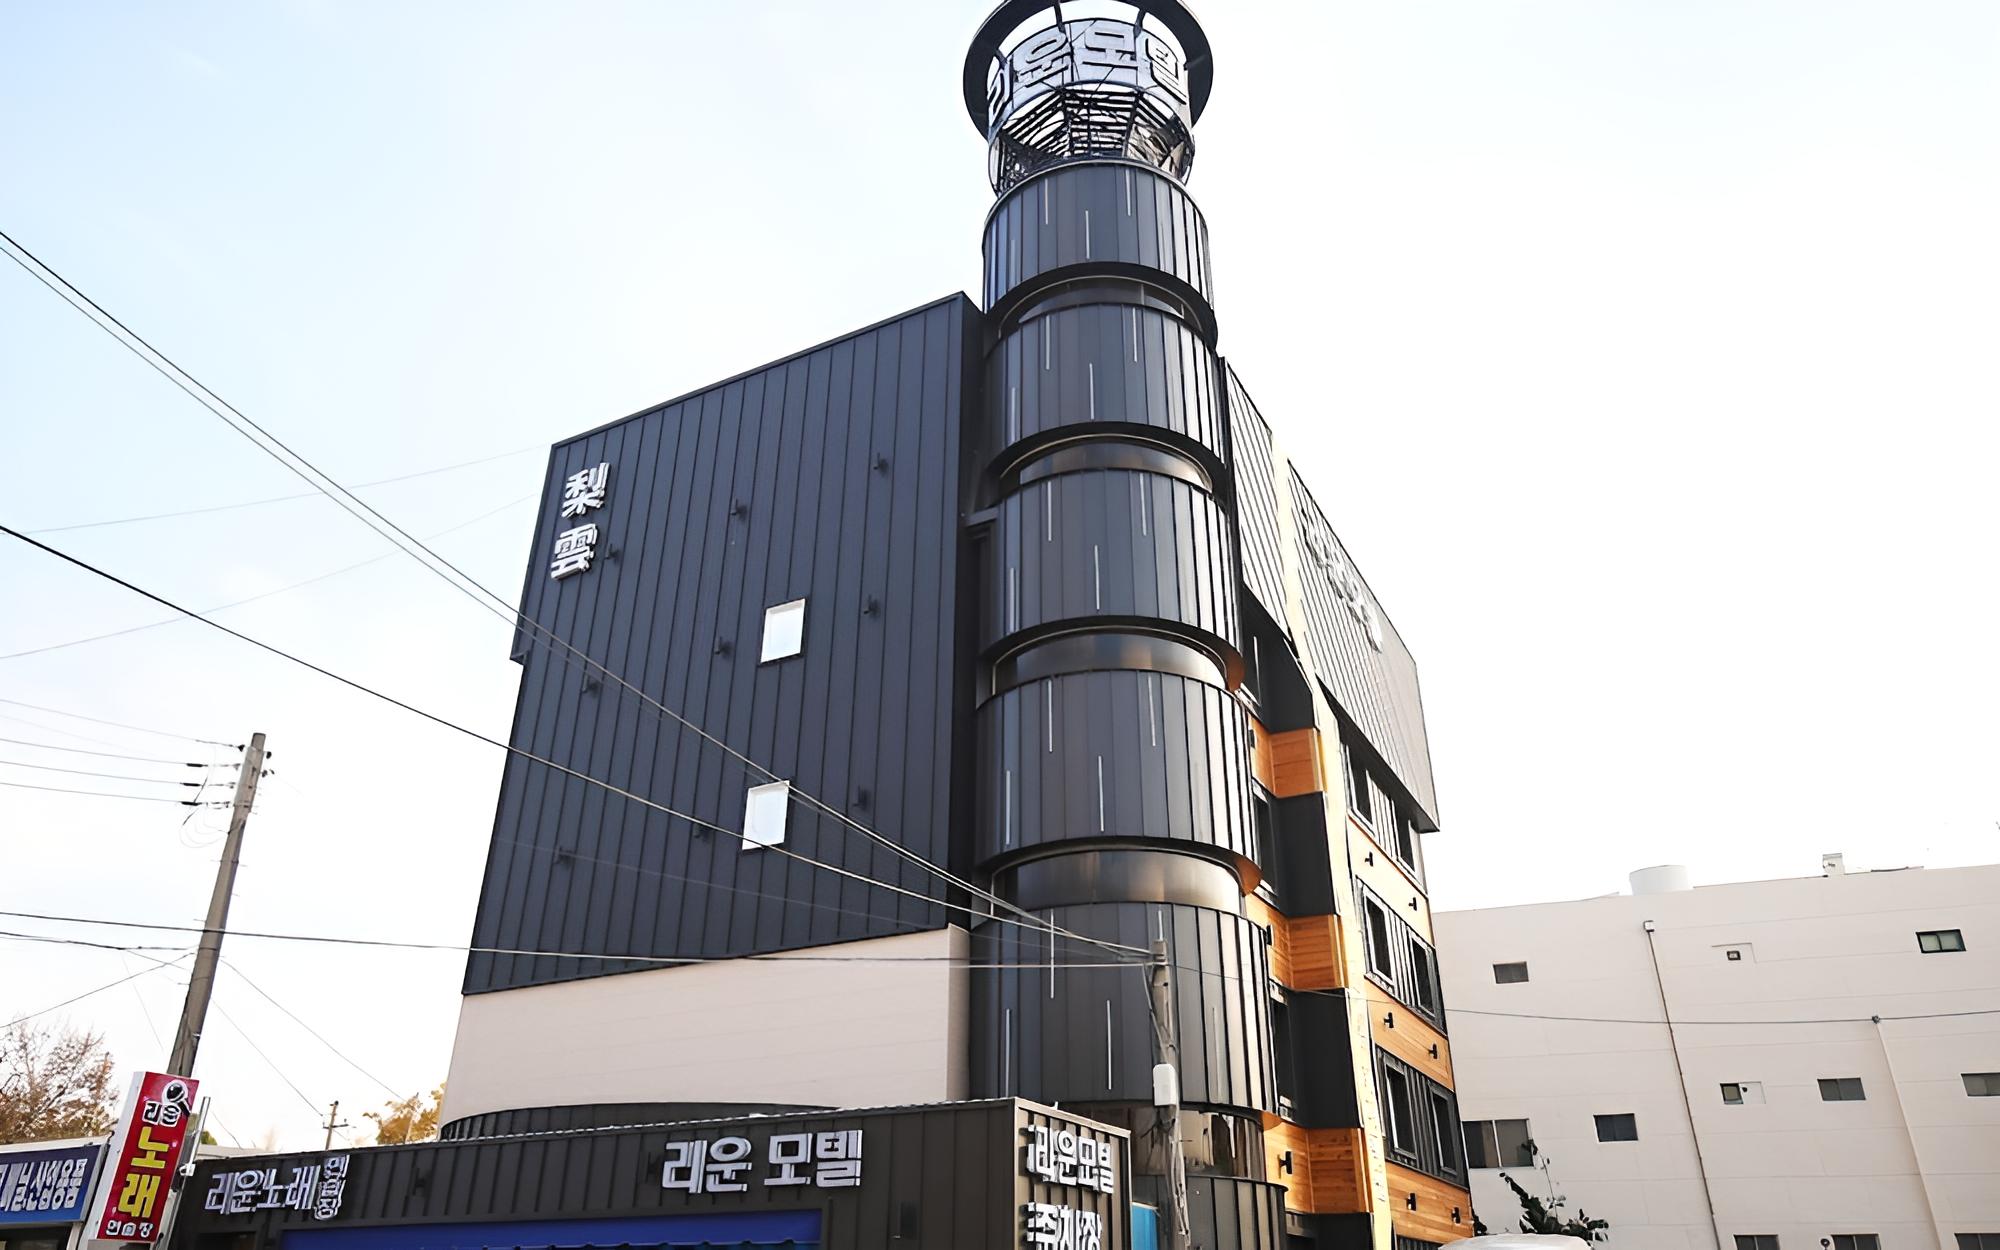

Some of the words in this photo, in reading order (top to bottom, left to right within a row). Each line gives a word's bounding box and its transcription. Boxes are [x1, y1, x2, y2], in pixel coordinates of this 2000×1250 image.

[551, 462, 610, 579] 梨雲
[118, 1126, 169, 1218] 노래
[764, 1130, 863, 1187] 모텔
